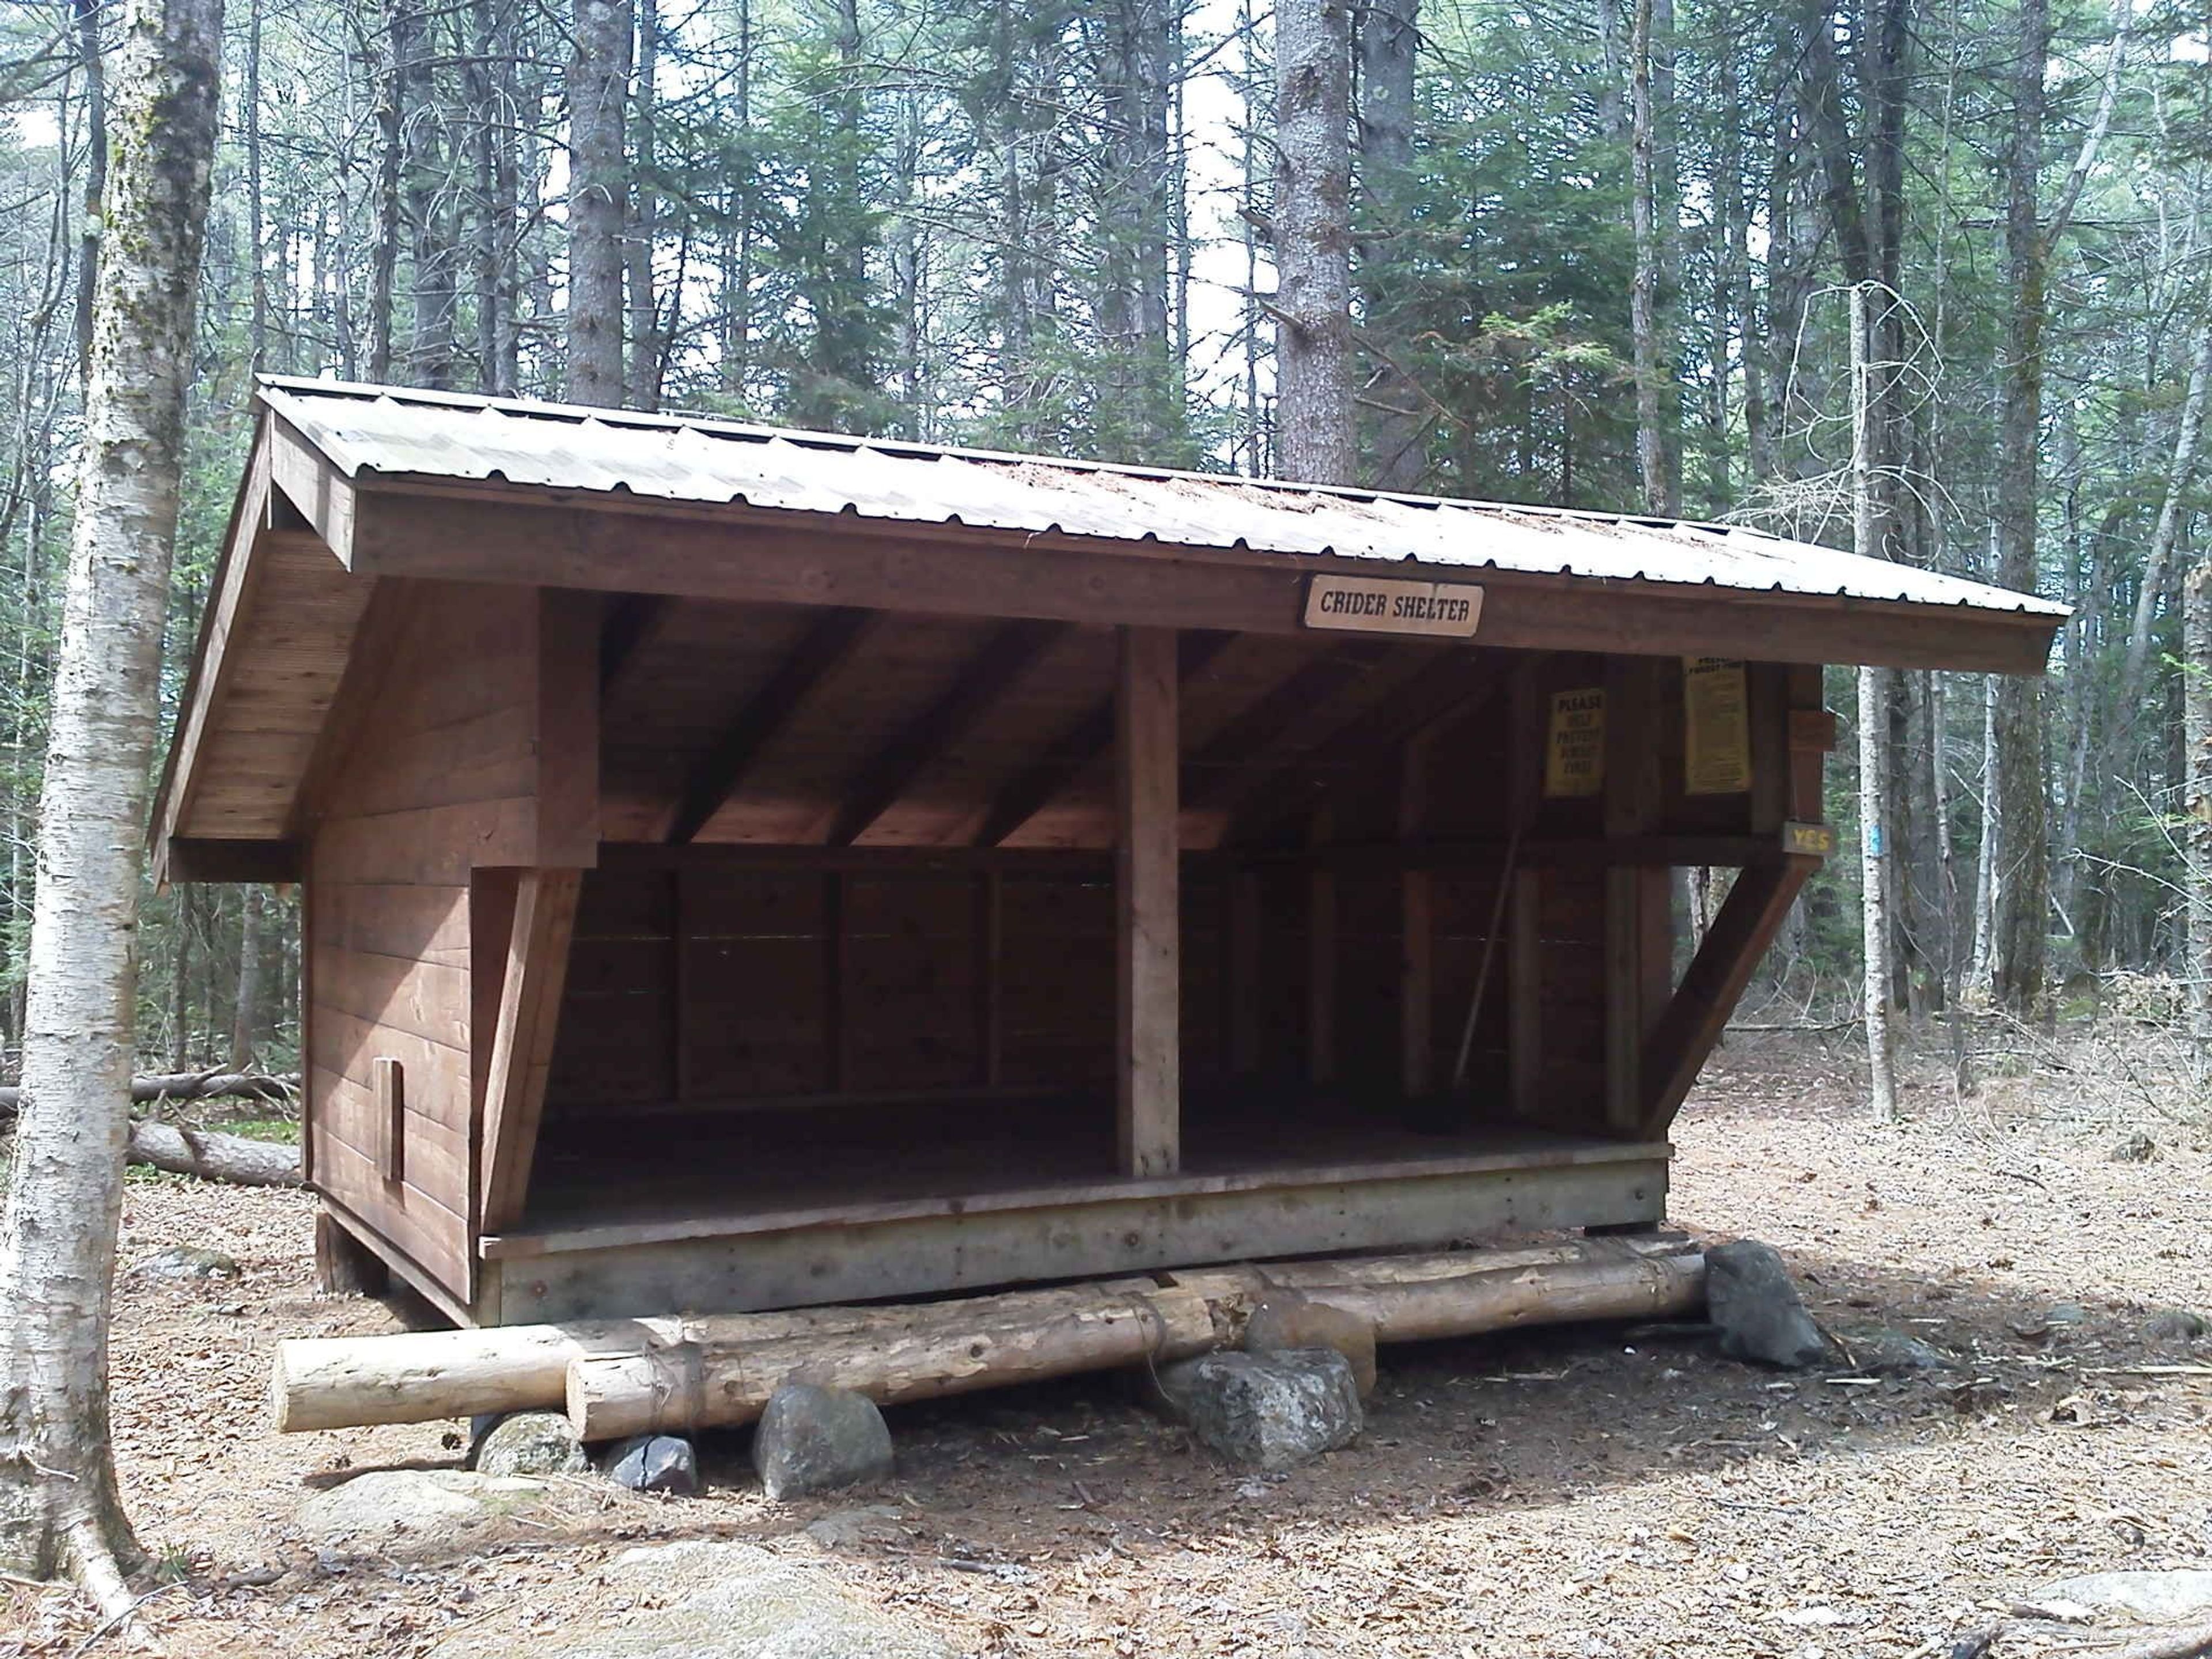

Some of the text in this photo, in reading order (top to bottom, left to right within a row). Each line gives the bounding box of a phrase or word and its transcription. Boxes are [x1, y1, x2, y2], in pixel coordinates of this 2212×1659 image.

[1321, 591, 1469, 620] CRIDER SHELTER
[1558, 695, 1601, 712] PLEASE
[1794, 829, 1828, 850] YES
